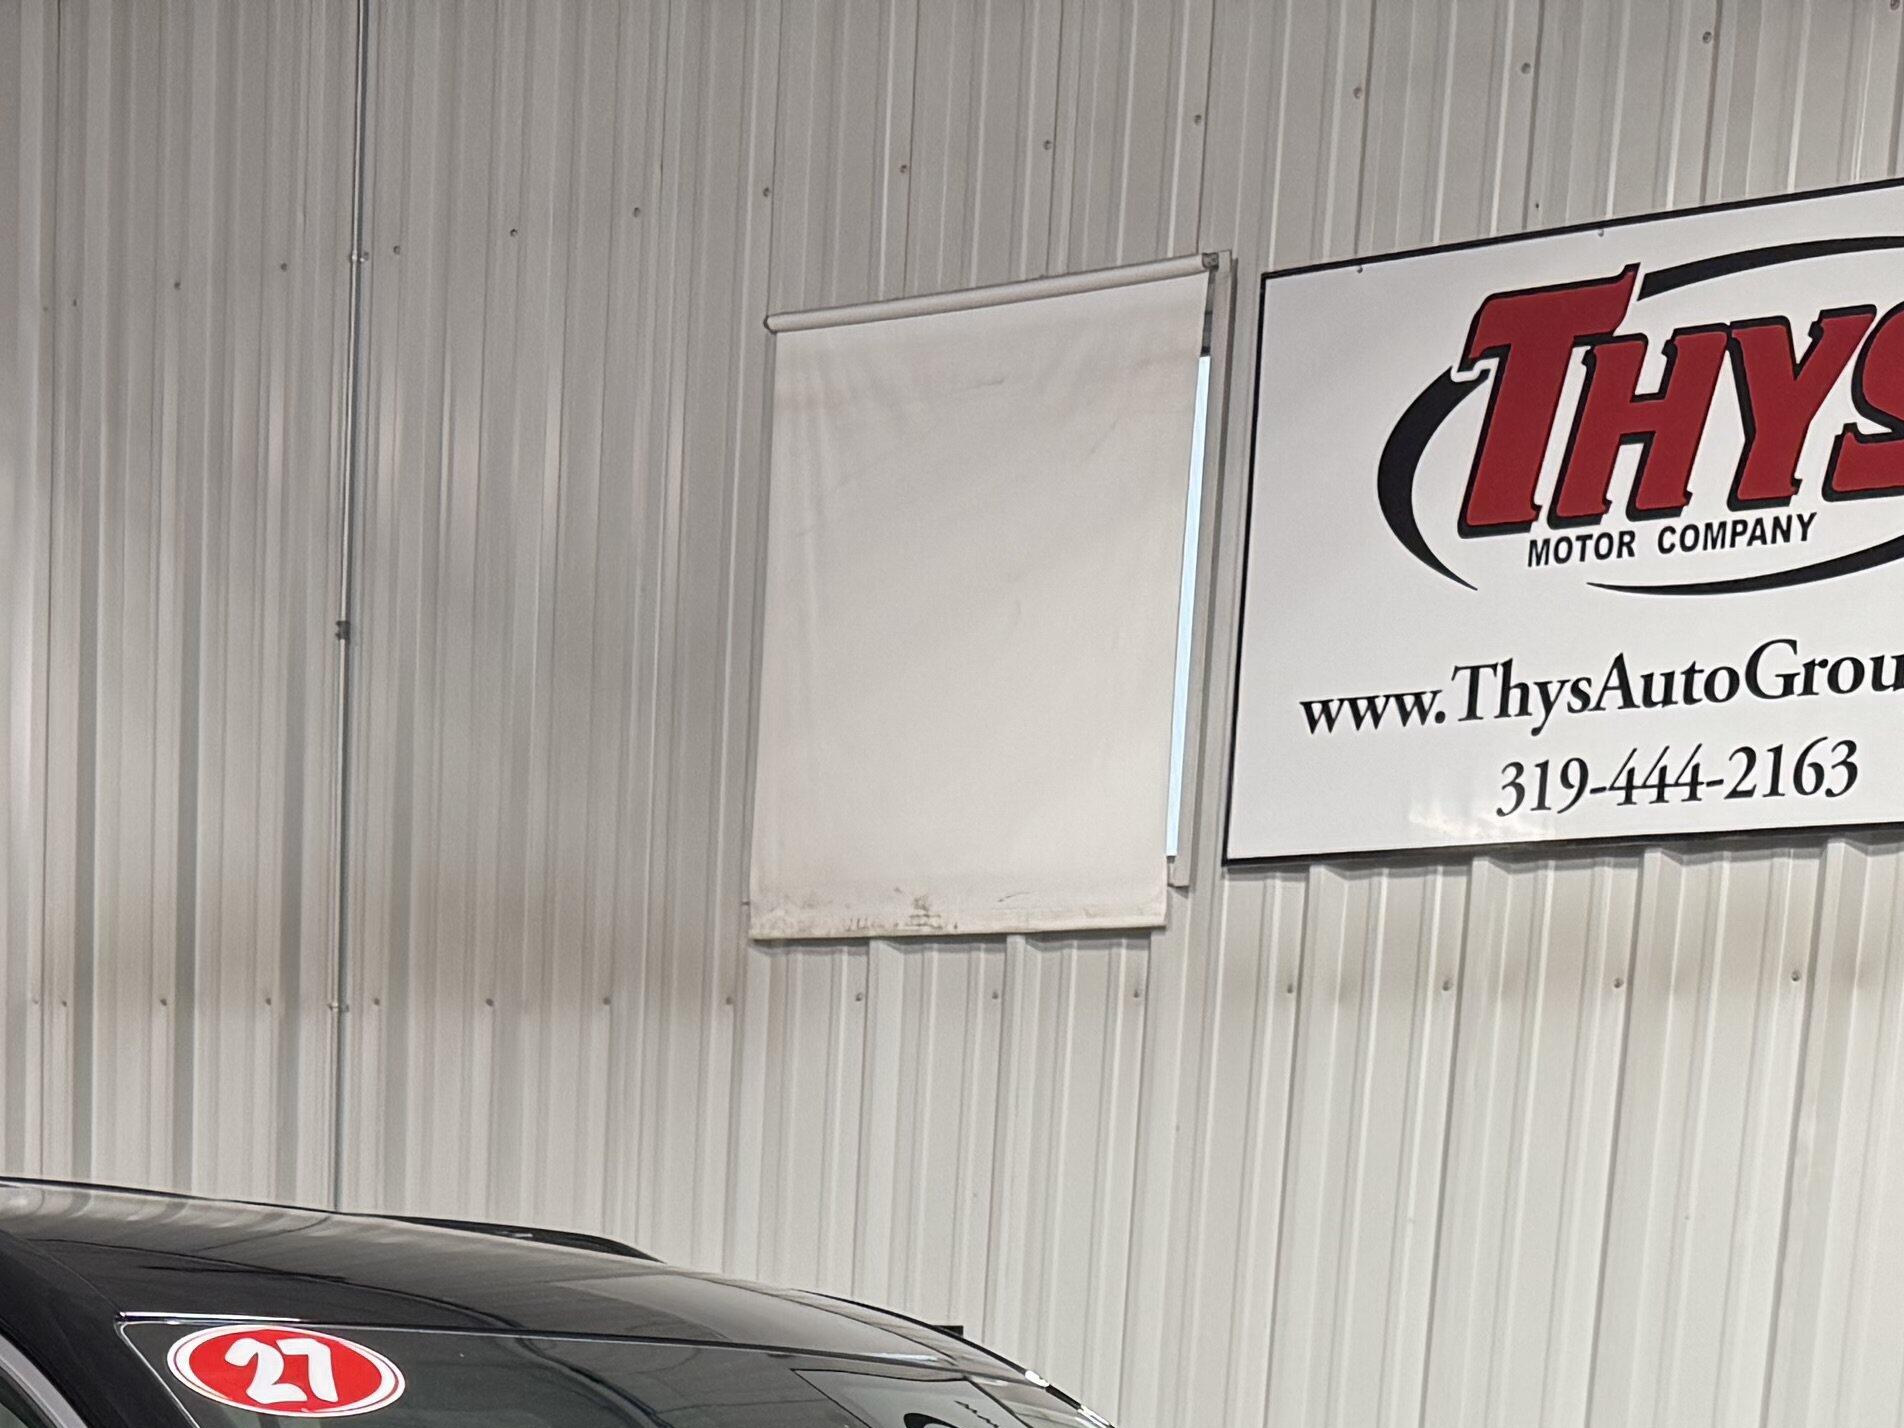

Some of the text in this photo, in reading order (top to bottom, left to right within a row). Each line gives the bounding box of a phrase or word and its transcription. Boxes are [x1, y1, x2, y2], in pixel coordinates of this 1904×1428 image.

[1527, 511, 1817, 570] MOTOR COMPANY
[1496, 736, 1860, 818] 319-444-2163
[224, 1337, 339, 1405] 27
